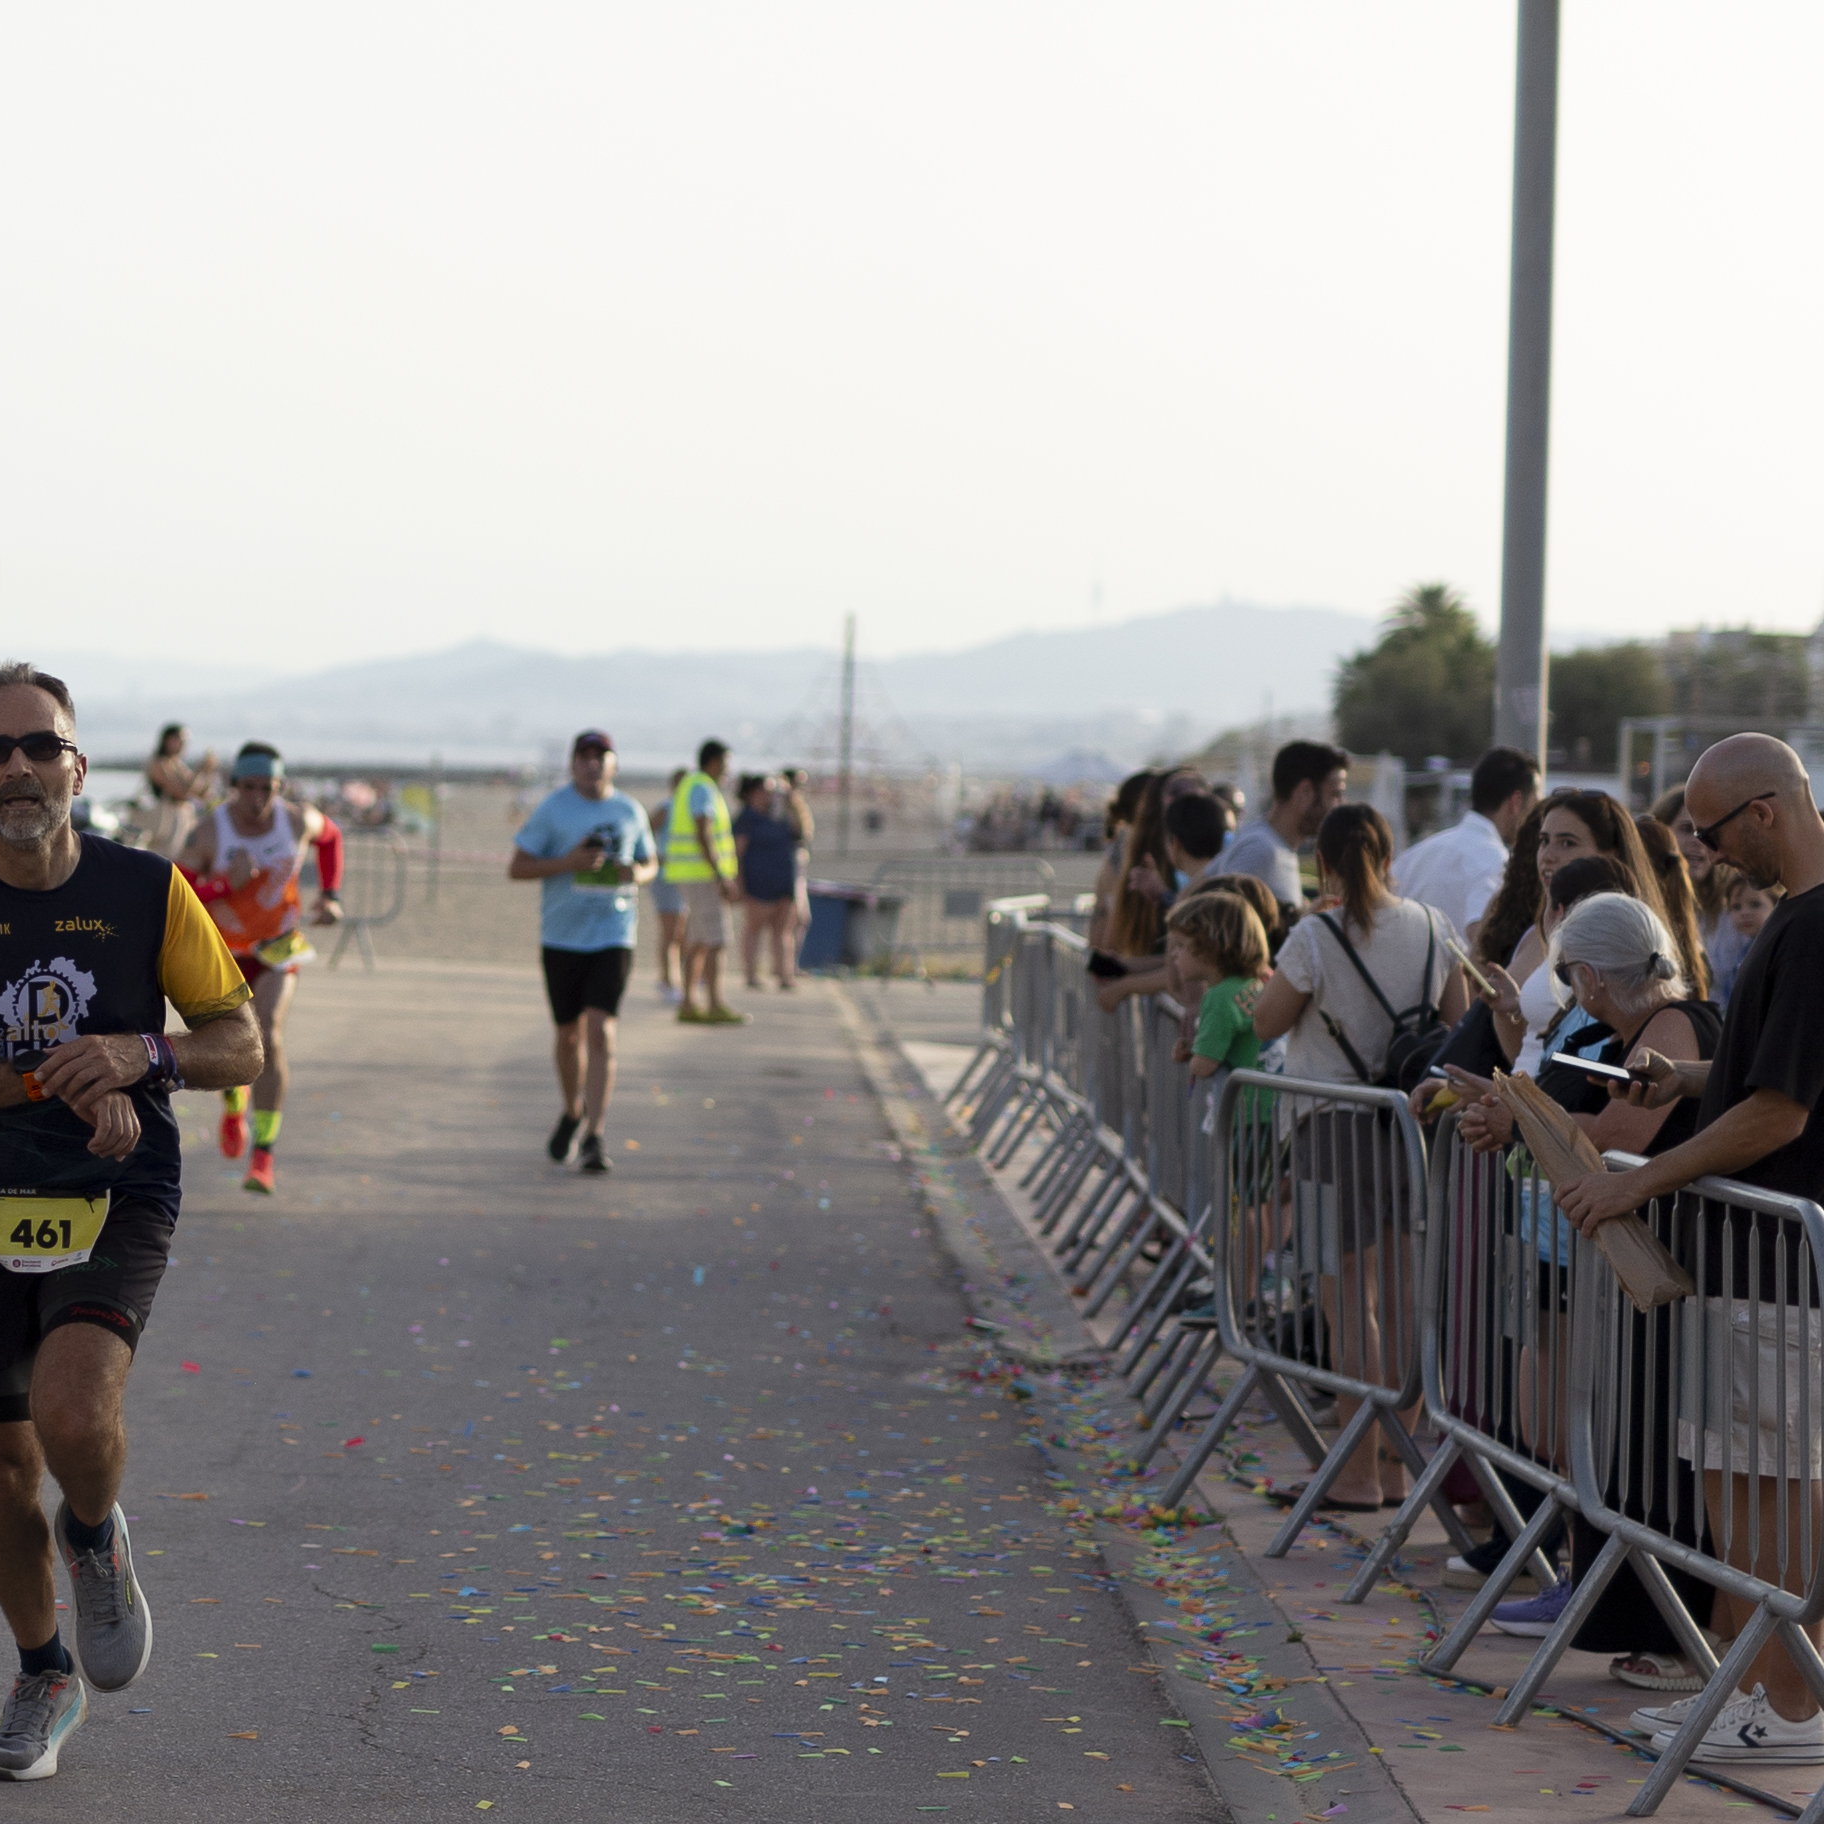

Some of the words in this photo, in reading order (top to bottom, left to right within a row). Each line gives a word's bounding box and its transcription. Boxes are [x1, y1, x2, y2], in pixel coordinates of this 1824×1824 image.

[54, 916, 106, 932] zalux
[6, 1018, 61, 1042] alto
[10, 1219, 71, 1249] 461
